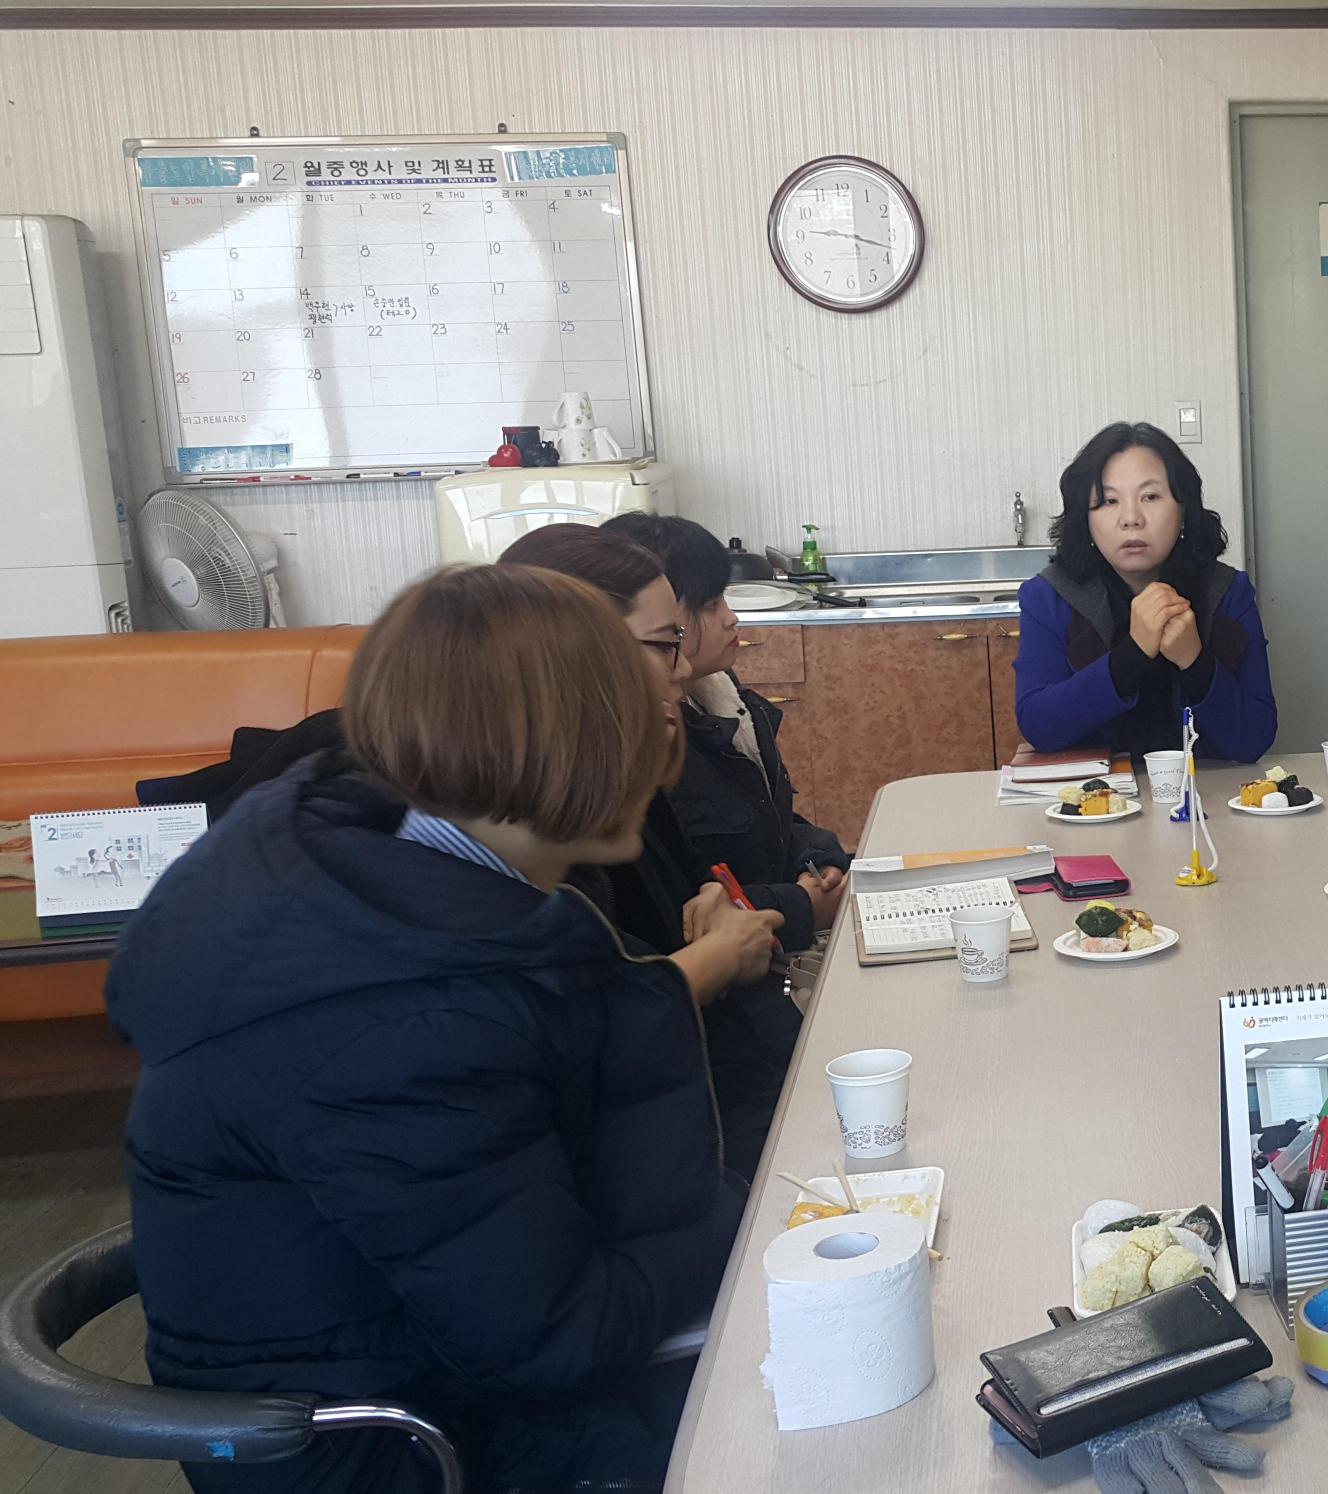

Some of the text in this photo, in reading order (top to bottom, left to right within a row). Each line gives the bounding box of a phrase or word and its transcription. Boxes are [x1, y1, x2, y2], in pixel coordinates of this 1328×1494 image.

[272, 163, 288, 181] 2
[303, 160, 393, 178] 월중행사
[404, 160, 422, 175] 및
[432, 158, 497, 176] 계획표
[319, 194, 335, 202] TUE
[383, 192, 402, 200] WED
[449, 191, 465, 199] THU
[578, 189, 593, 197] SAT
[185, 196, 203, 204] SUN
[250, 195, 272, 203] MON
[364, 285, 376, 297] 15
[428, 284, 439, 296] 16
[493, 282, 505, 295] 17
[557, 281, 570, 293] 18
[166, 291, 177, 301] 12
[233, 290, 244, 301] 13
[300, 288, 310, 299] 14
[368, 326, 382, 336] 22
[432, 324, 447, 335] 23
[496, 322, 509, 334] 24
[561, 321, 575, 332] 25
[171, 333, 182, 343] 19
[236, 331, 251, 341] 20
[304, 328, 314, 338] 21
[176, 373, 190, 383] 26
[242, 371, 256, 381] 27
[307, 369, 322, 380] 28
[203, 415, 247, 424] REMARKS
